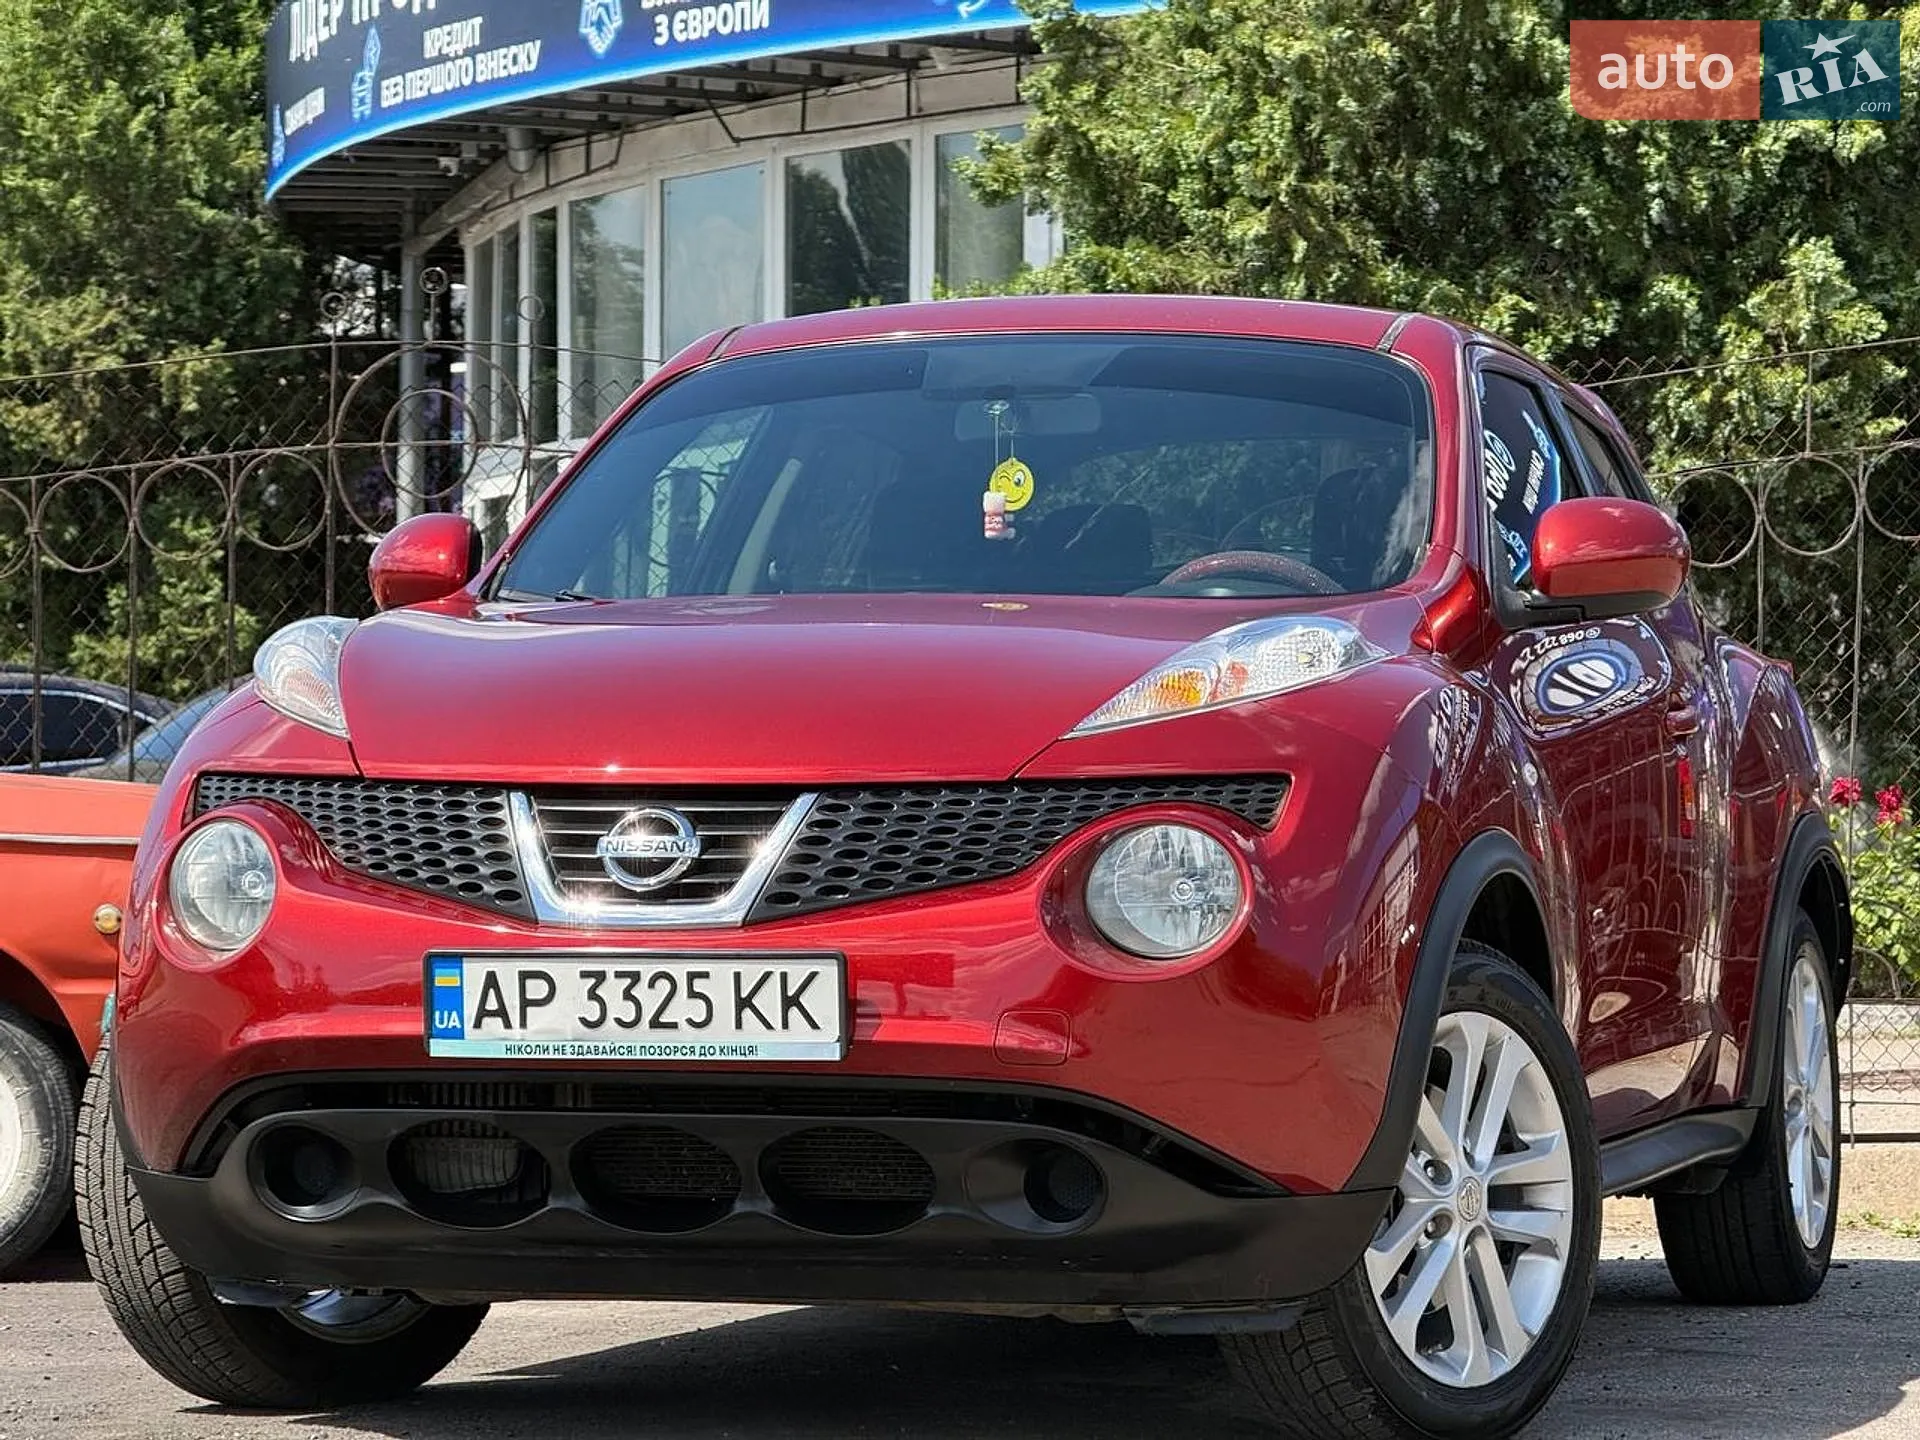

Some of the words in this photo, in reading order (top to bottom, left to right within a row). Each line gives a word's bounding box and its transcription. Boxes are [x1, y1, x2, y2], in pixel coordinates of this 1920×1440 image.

[423, 16, 483, 59] КРЕДИТ
[654, 13, 670, 46] З
[673, 0, 769, 42] ЄВРОПИ
[380, 77, 404, 108] БЕЗ
[406, 57, 474, 100] ПЕРШОГО
[475, 40, 541, 83] ВНЕСКУ
[606, 839, 687, 853] NISSAN
[435, 1011, 461, 1028] UA
[473, 970, 556, 1030] AP
[578, 970, 713, 1029] 3325
[733, 971, 821, 1030] KK
[505, 1044, 552, 1057] НІКОЛИ
[552, 1045, 567, 1057] НЕ
[570, 1042, 637, 1058] ЗДАВАЙСЯ!
[639, 1045, 697, 1057] ПОЗОРСЯ
[699, 1046, 717, 1059] ДО
[719, 1045, 758, 1059] КІНЦЯ!
